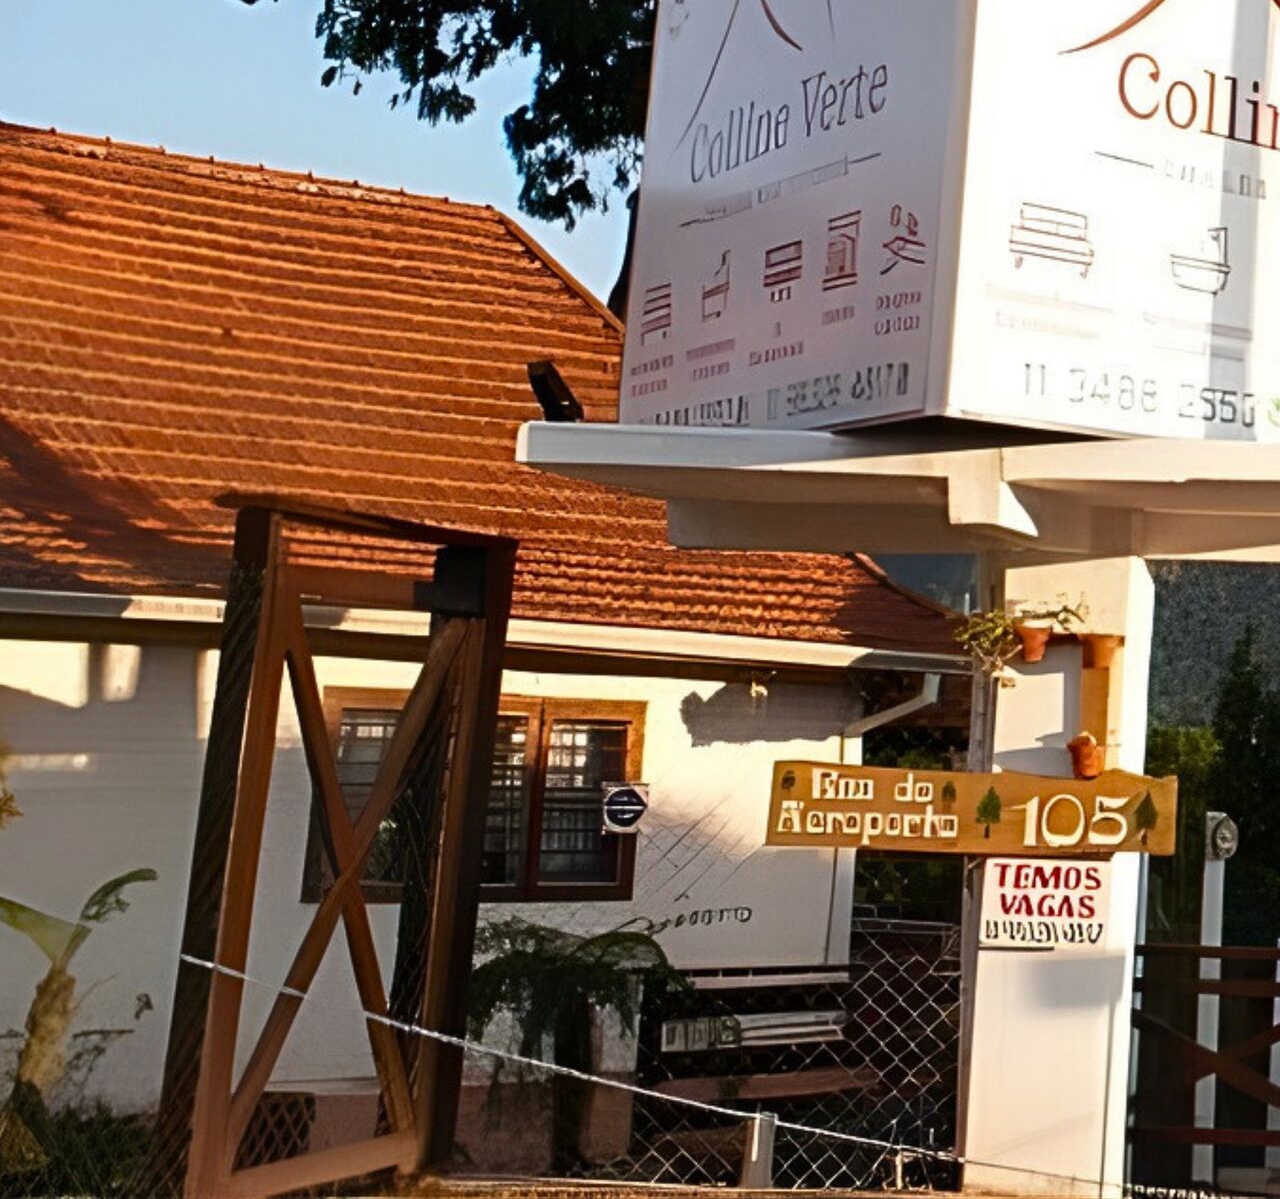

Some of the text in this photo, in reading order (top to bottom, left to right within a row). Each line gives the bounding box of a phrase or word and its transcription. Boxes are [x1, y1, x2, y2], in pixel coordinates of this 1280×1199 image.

[690, 64, 888, 183] Colline Verte
[894, 772, 933, 803] do
[1003, 793, 1131, 848] 105
[994, 862, 1102, 890] TEMOS
[1000, 892, 1096, 919] VAGAS
